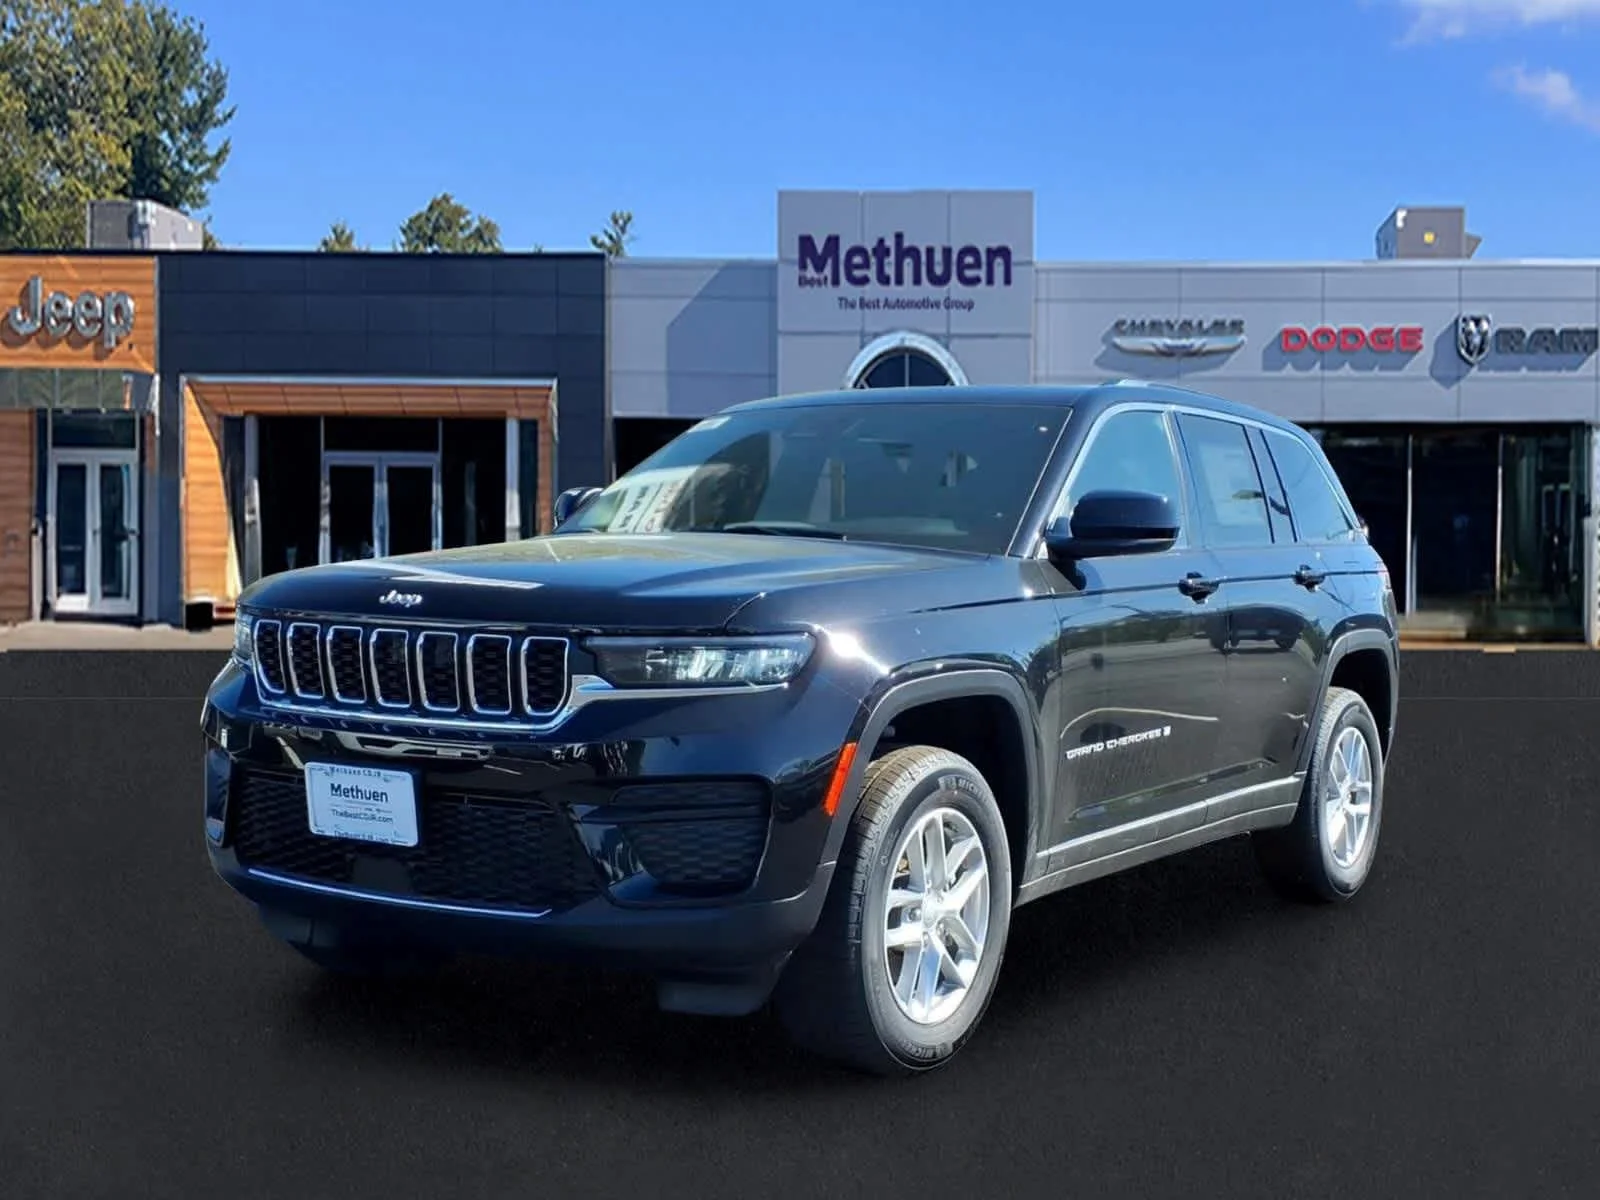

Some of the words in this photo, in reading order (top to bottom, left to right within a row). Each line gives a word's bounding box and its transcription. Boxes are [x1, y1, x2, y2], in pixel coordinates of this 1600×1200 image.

[798, 231, 1012, 287] Methuen
[8, 275, 136, 348] Jeep
[838, 297, 857, 309] The
[859, 297, 881, 310] Best
[883, 297, 941, 310] Automotive
[944, 297, 975, 312] Group
[1281, 326, 1424, 352] DODGE
[1495, 327, 1598, 354] RAM
[379, 590, 423, 608] Jeep
[1066, 741, 1105, 760] GRAND
[1106, 728, 1162, 749] CHEROKEE
[330, 782, 388, 803] Methuen
